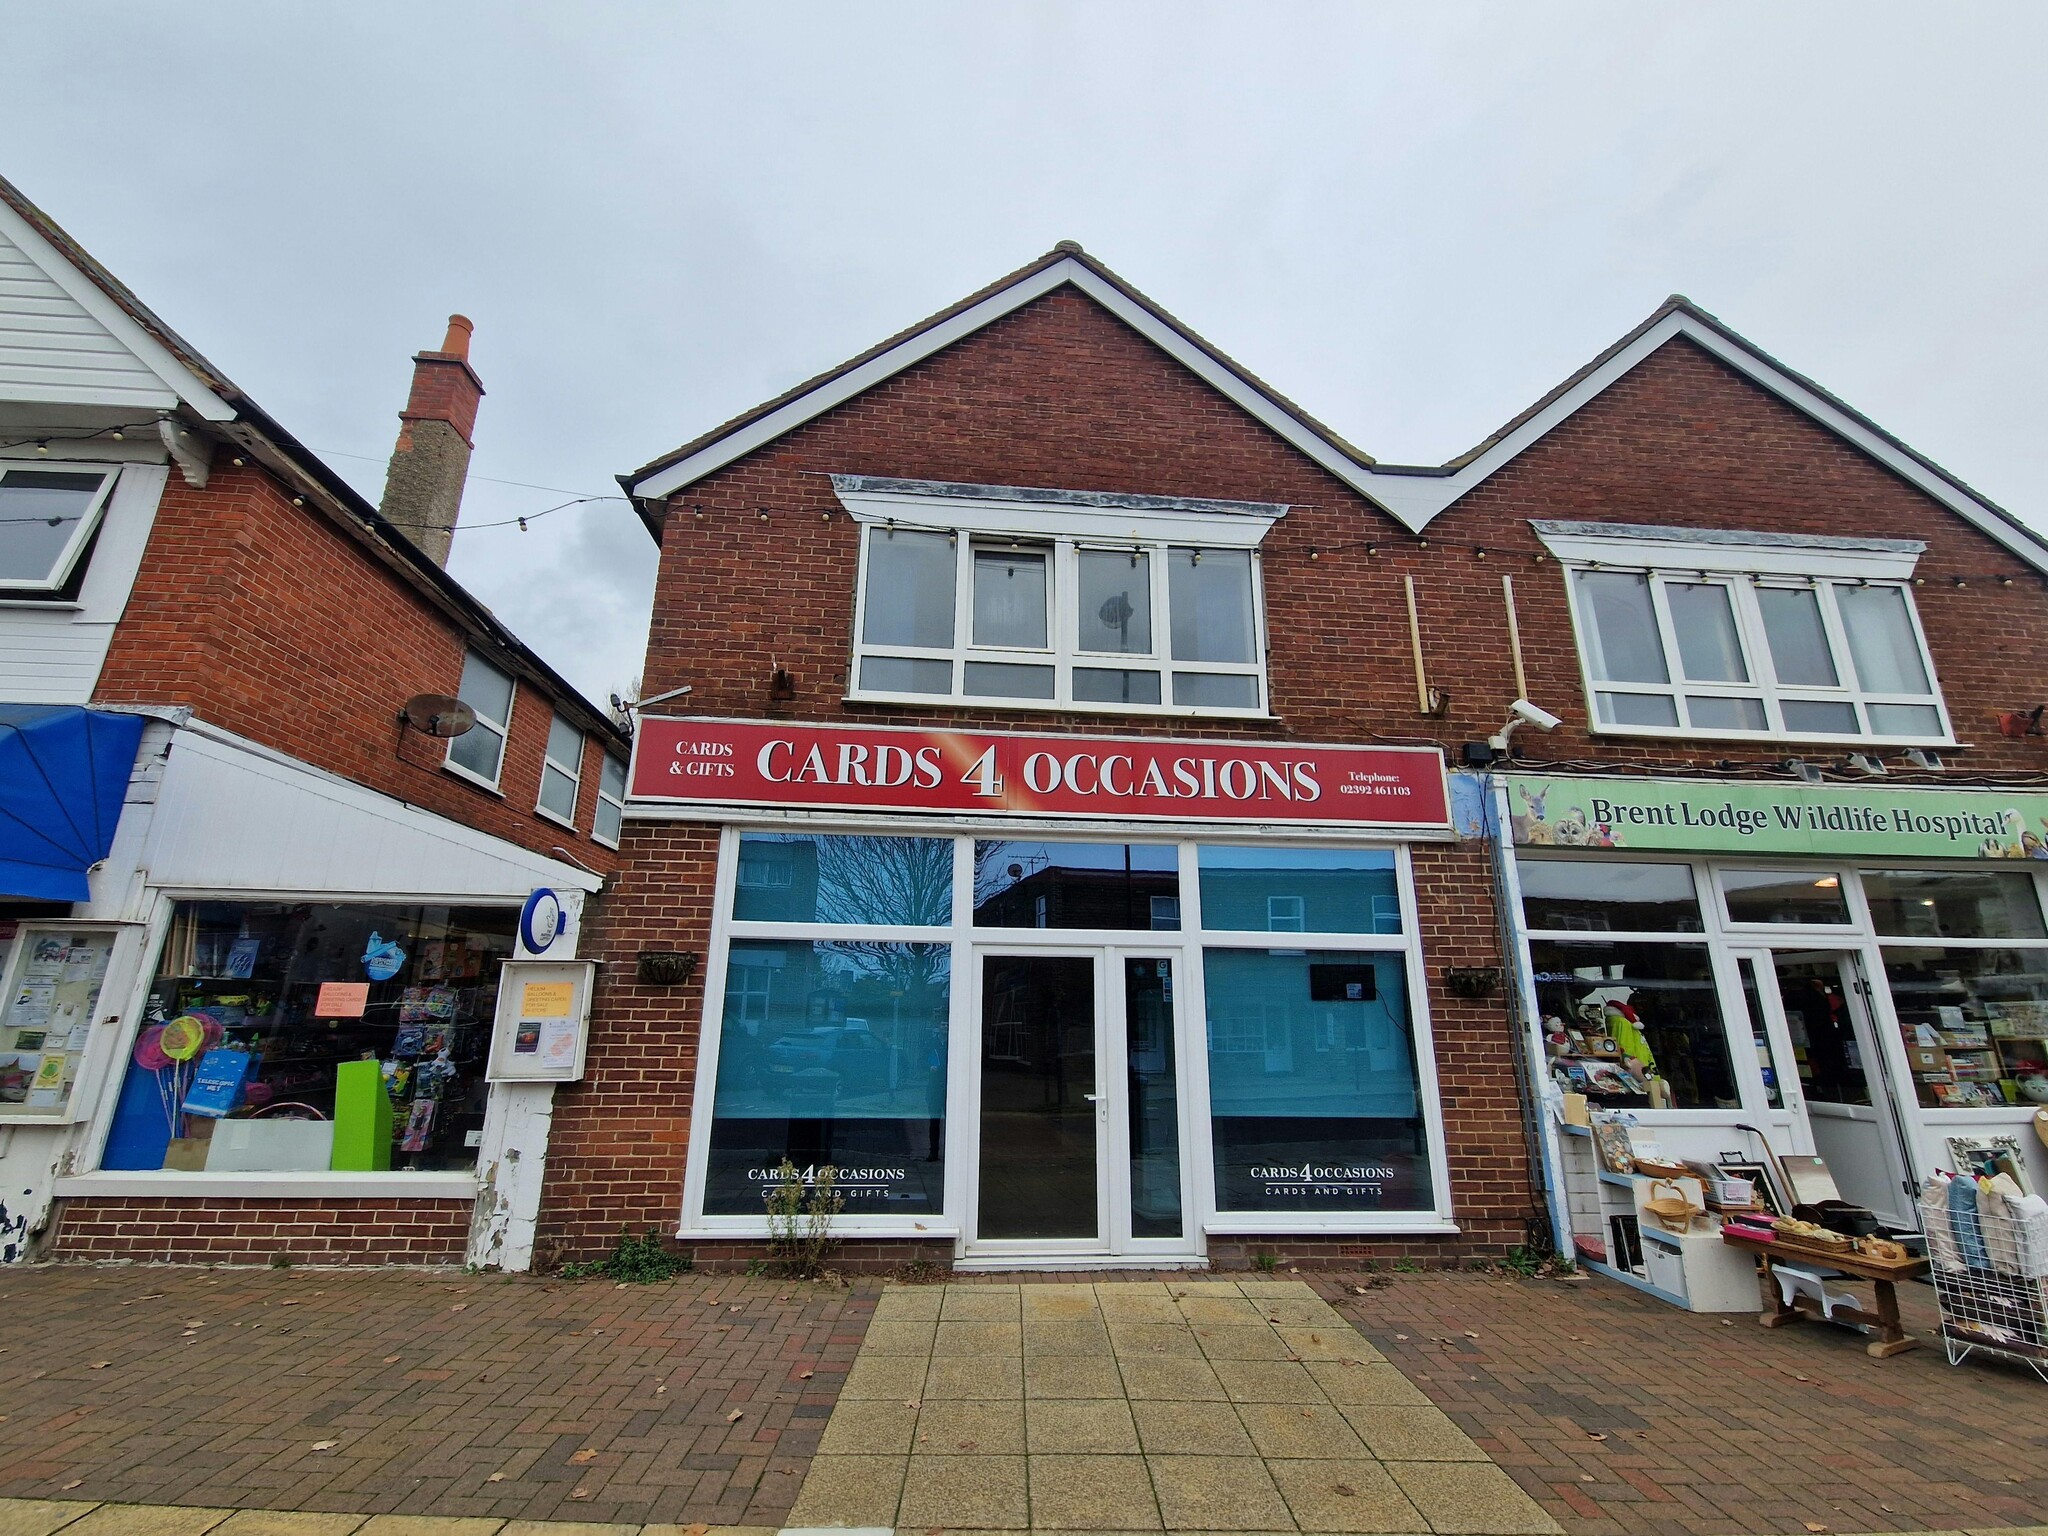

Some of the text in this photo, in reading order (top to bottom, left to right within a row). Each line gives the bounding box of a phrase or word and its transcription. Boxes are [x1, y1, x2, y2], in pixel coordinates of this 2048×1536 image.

[676, 741, 733, 757] CARDS
[669, 760, 735, 777] & GIFTS
[756, 739, 1321, 802] CARDS 4 OCCASIONS
[1348, 771, 1400, 784] Telephone:
[1340, 785, 1411, 796] 02392 461103
[1590, 798, 2008, 840] Brent Lodge Wildlife Hospital
[850, 1189, 889, 1197] GIFTS
[1265, 1187, 1383, 1195] CARDS AND GIFTS
